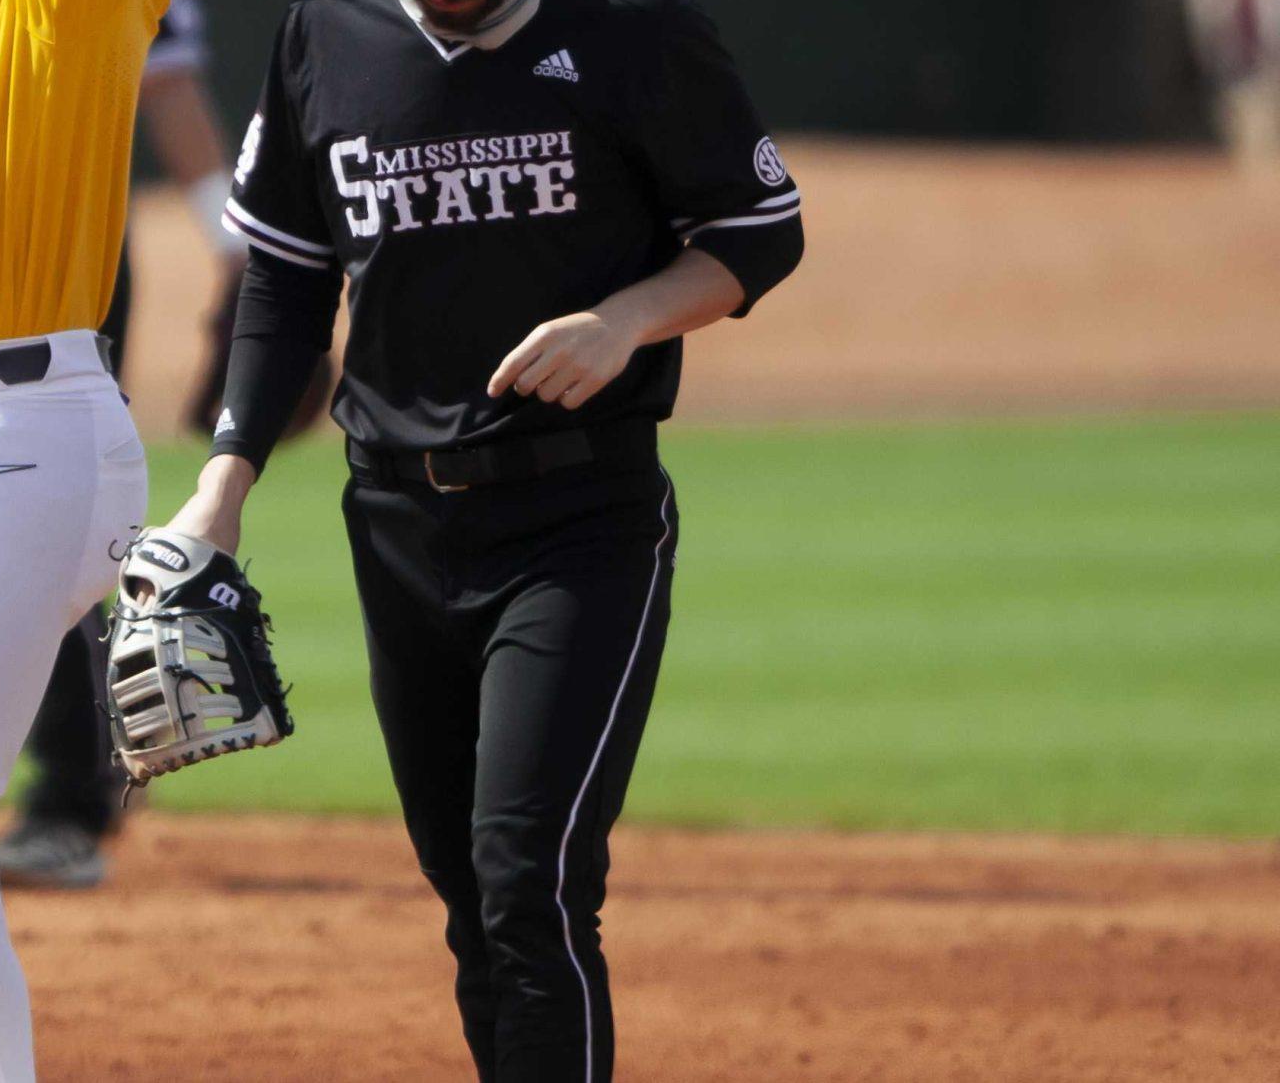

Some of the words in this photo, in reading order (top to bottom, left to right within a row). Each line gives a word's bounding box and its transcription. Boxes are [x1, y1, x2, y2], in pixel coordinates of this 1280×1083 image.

[533, 65, 579, 83] adidas
[372, 130, 572, 177] MISSISSIPPI
[329, 134, 577, 238] STATE
